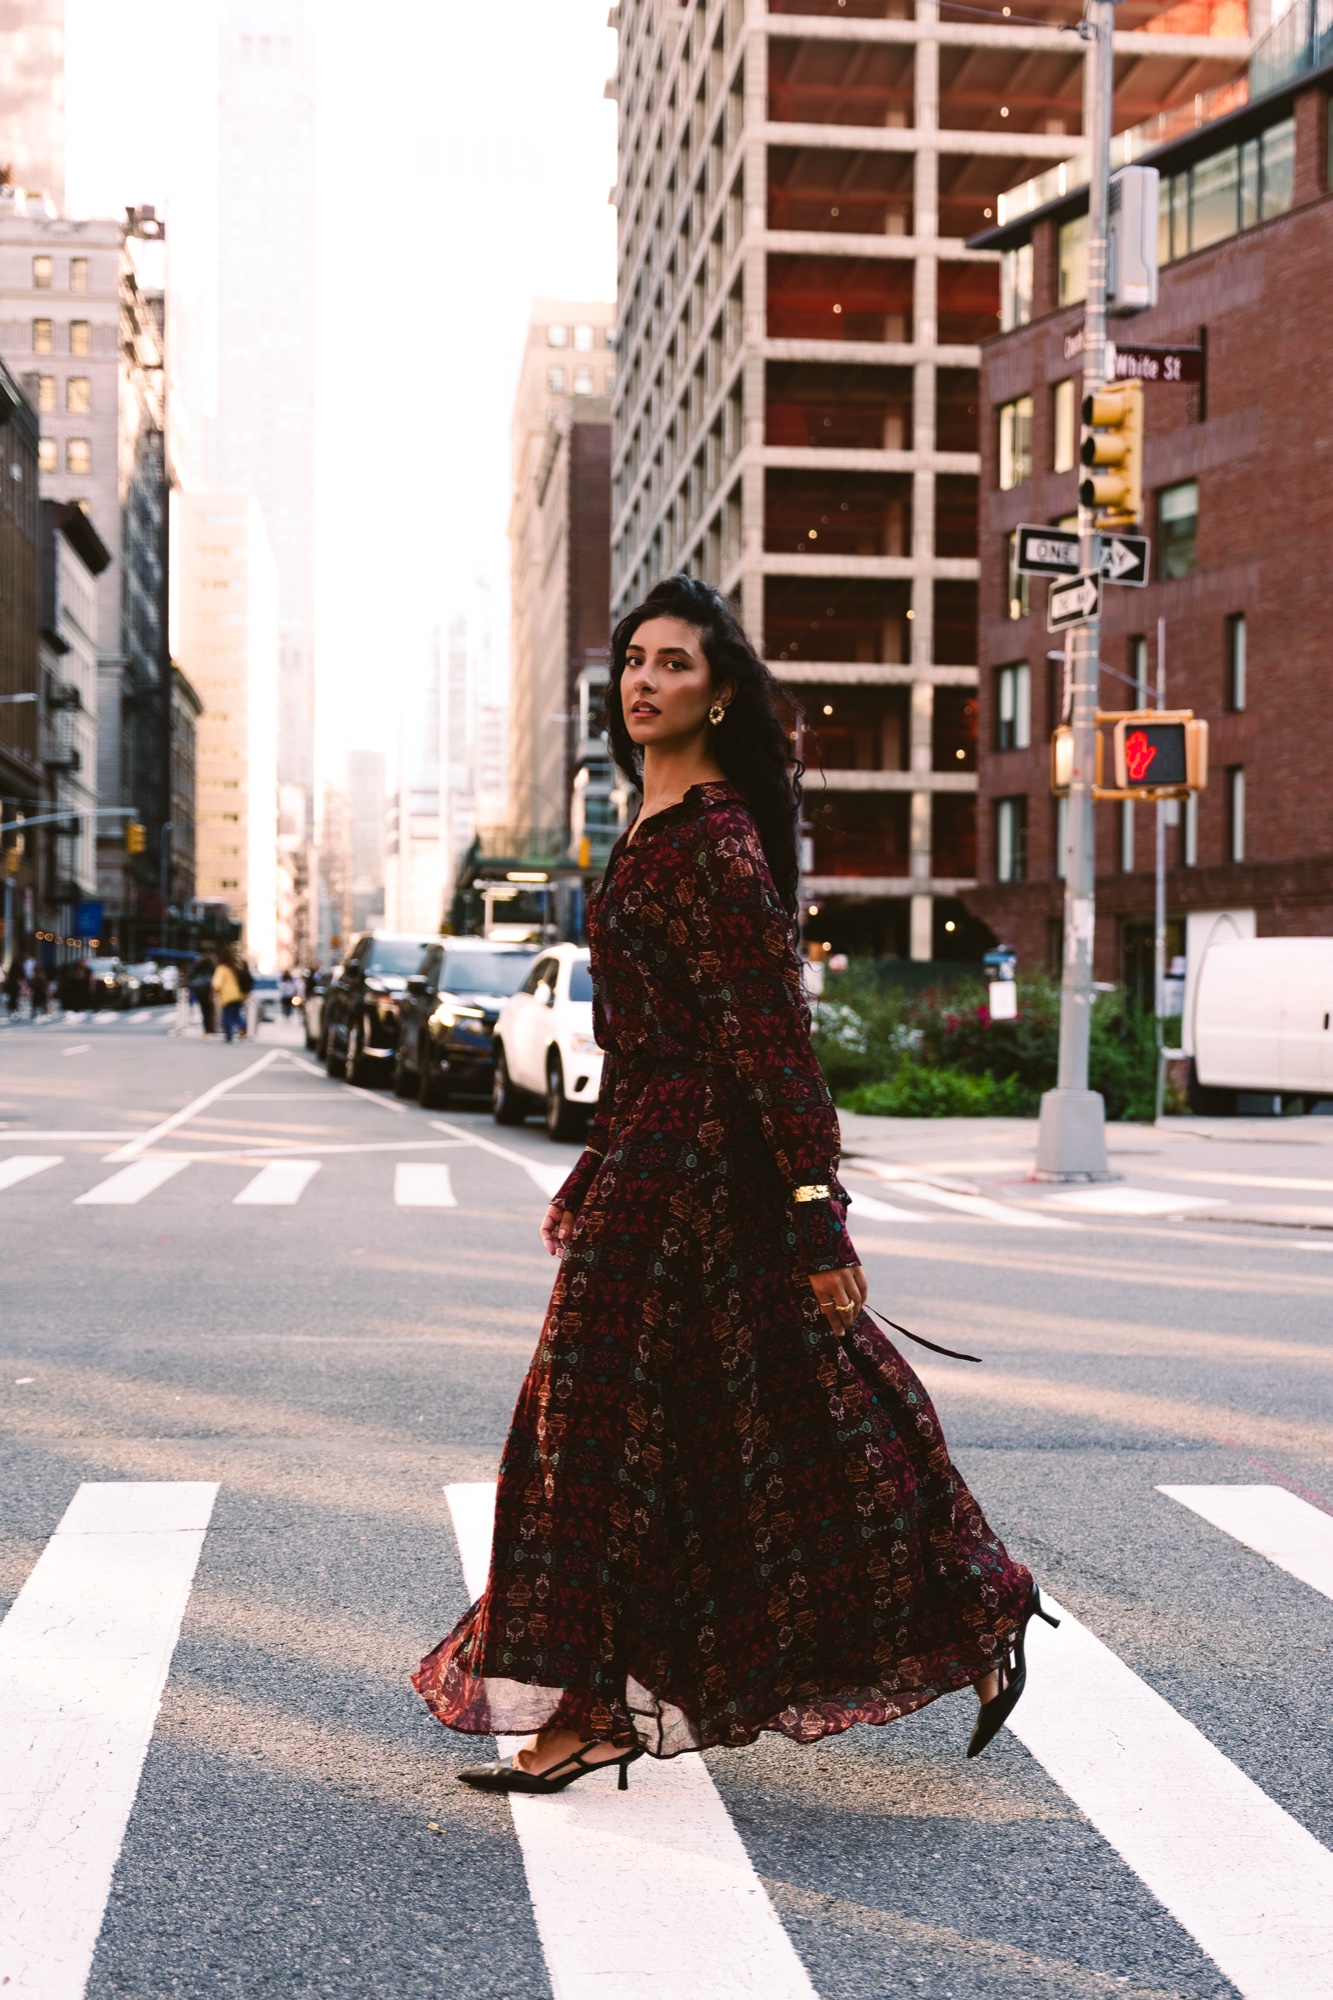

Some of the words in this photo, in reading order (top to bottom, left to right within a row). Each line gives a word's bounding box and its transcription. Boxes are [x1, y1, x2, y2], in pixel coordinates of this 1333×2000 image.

[1115, 353, 1159, 380] White
[1163, 355, 1182, 382] St
[1036, 540, 1074, 566] ONE
[1101, 546, 1129, 571] AY
